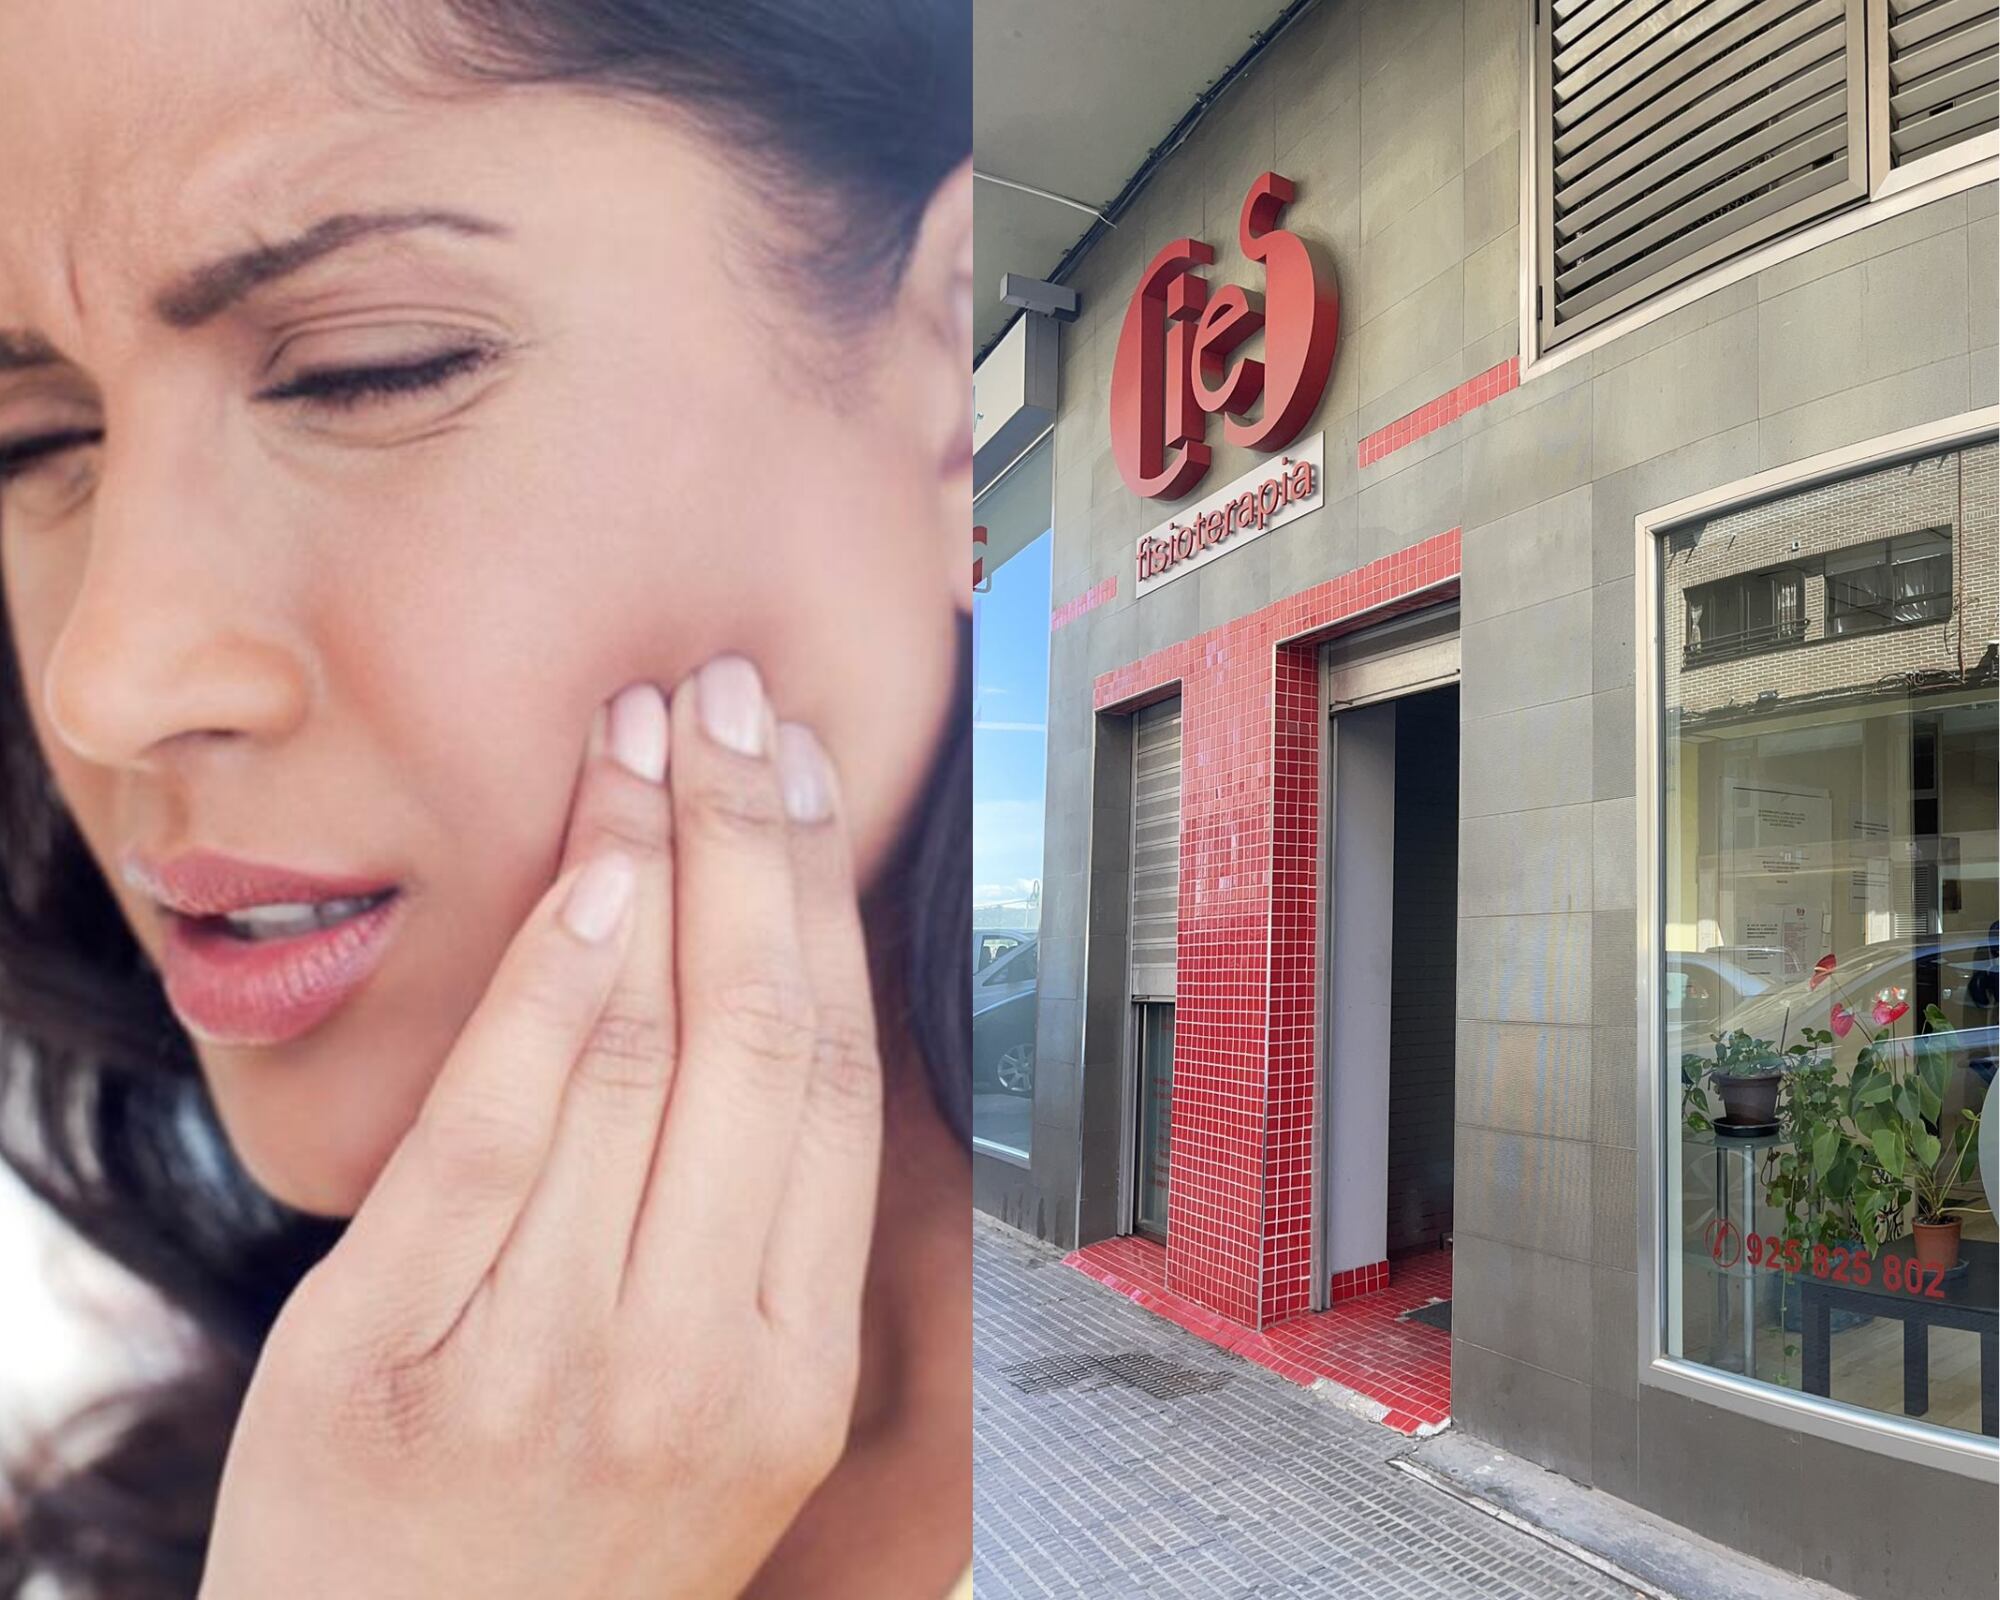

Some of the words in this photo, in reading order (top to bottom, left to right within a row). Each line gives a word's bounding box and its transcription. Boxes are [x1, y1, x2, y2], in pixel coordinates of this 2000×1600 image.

[1136, 456, 1314, 582] fisioterapia
[1746, 1232, 1801, 1273] 925
[1812, 1244, 1872, 1286] 825
[1883, 1255, 1946, 1298] 802
